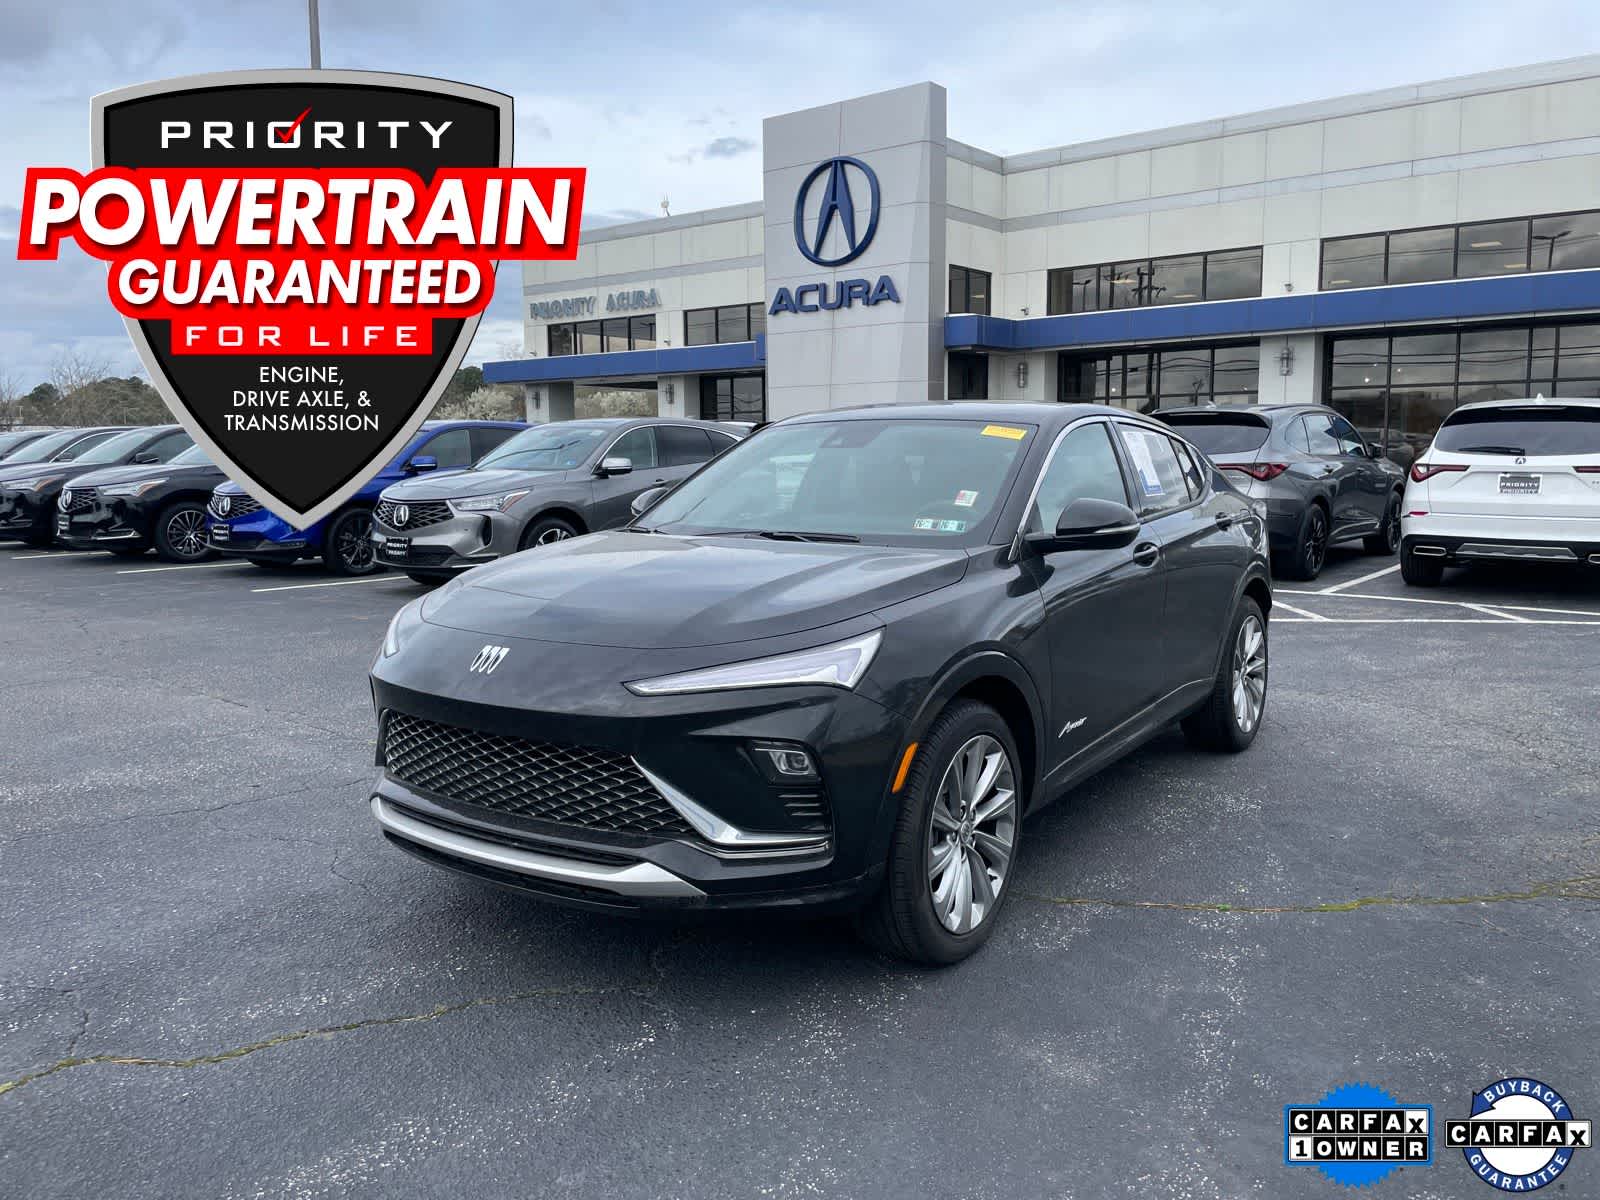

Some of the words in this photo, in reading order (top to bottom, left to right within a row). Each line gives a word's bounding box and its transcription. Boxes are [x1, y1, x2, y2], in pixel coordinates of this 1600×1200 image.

[529, 296, 597, 319] PRIORITY
[606, 288, 662, 312] ACURA
[768, 274, 900, 316] ACURA
